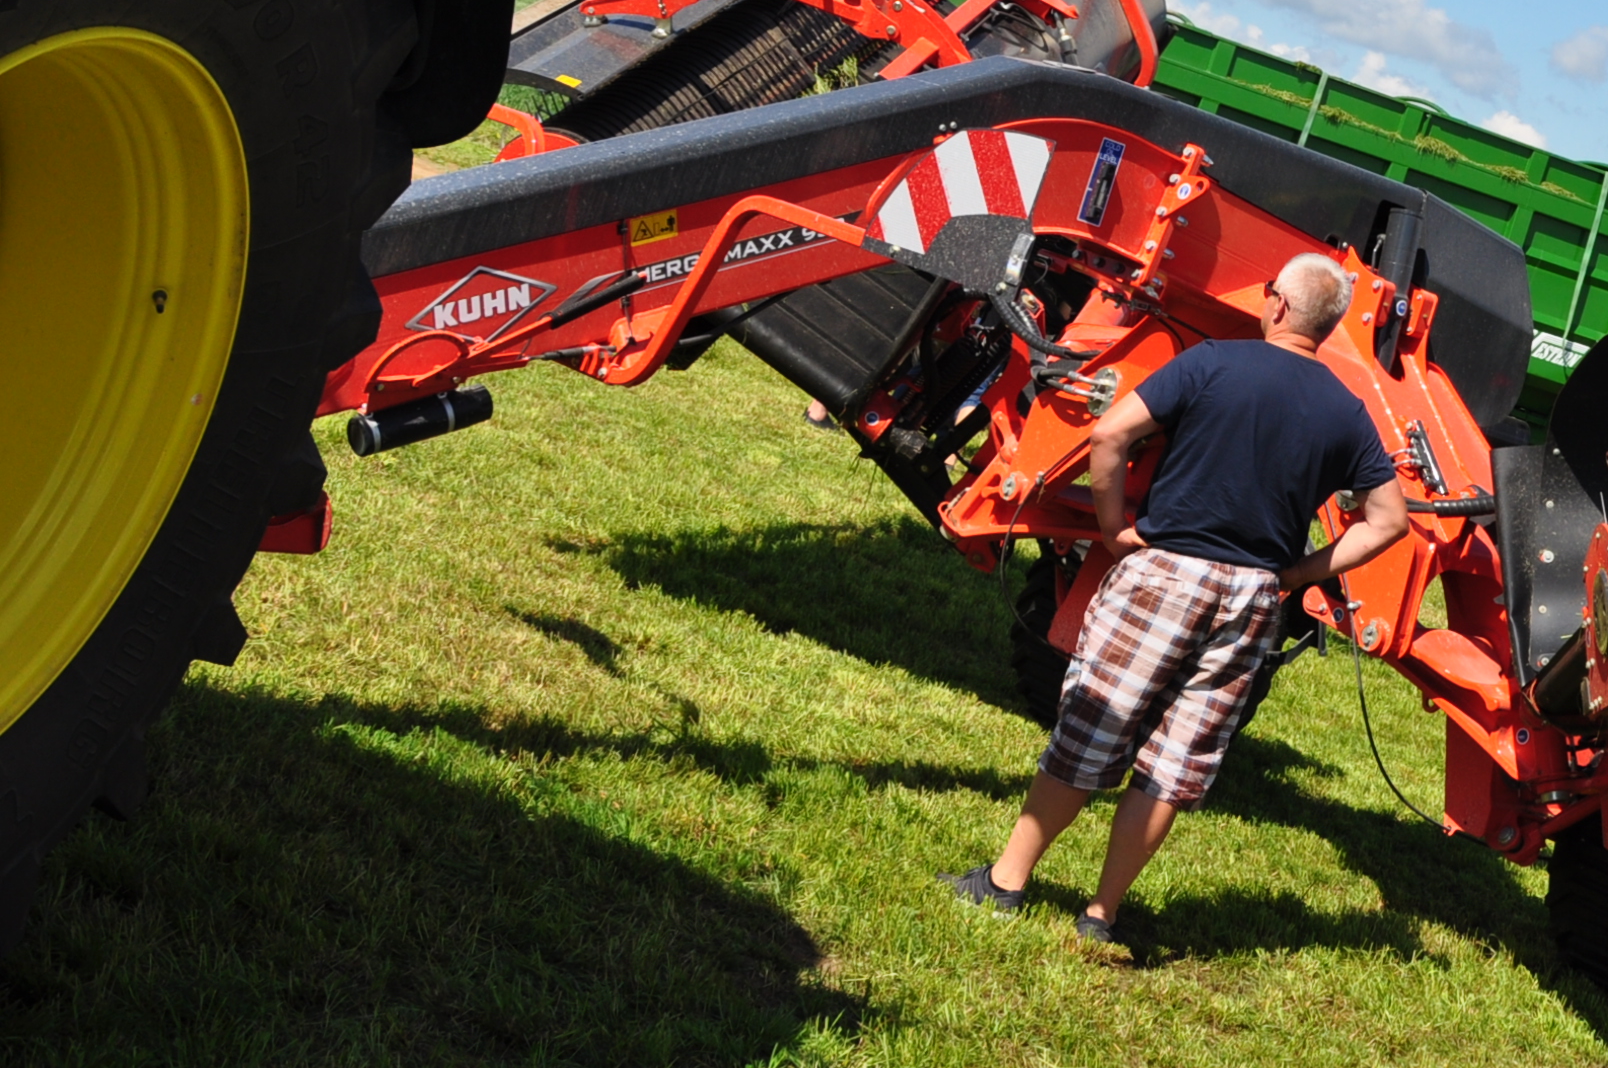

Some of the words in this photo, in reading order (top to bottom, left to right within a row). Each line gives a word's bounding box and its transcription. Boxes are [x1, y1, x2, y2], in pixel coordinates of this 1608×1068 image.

[1099, 152, 1118, 165] LEVEL
[632, 253, 701, 283] MERG
[723, 229, 794, 263] MAXX
[433, 283, 531, 330] KUHN
[1530, 329, 1584, 368] ESTERN
